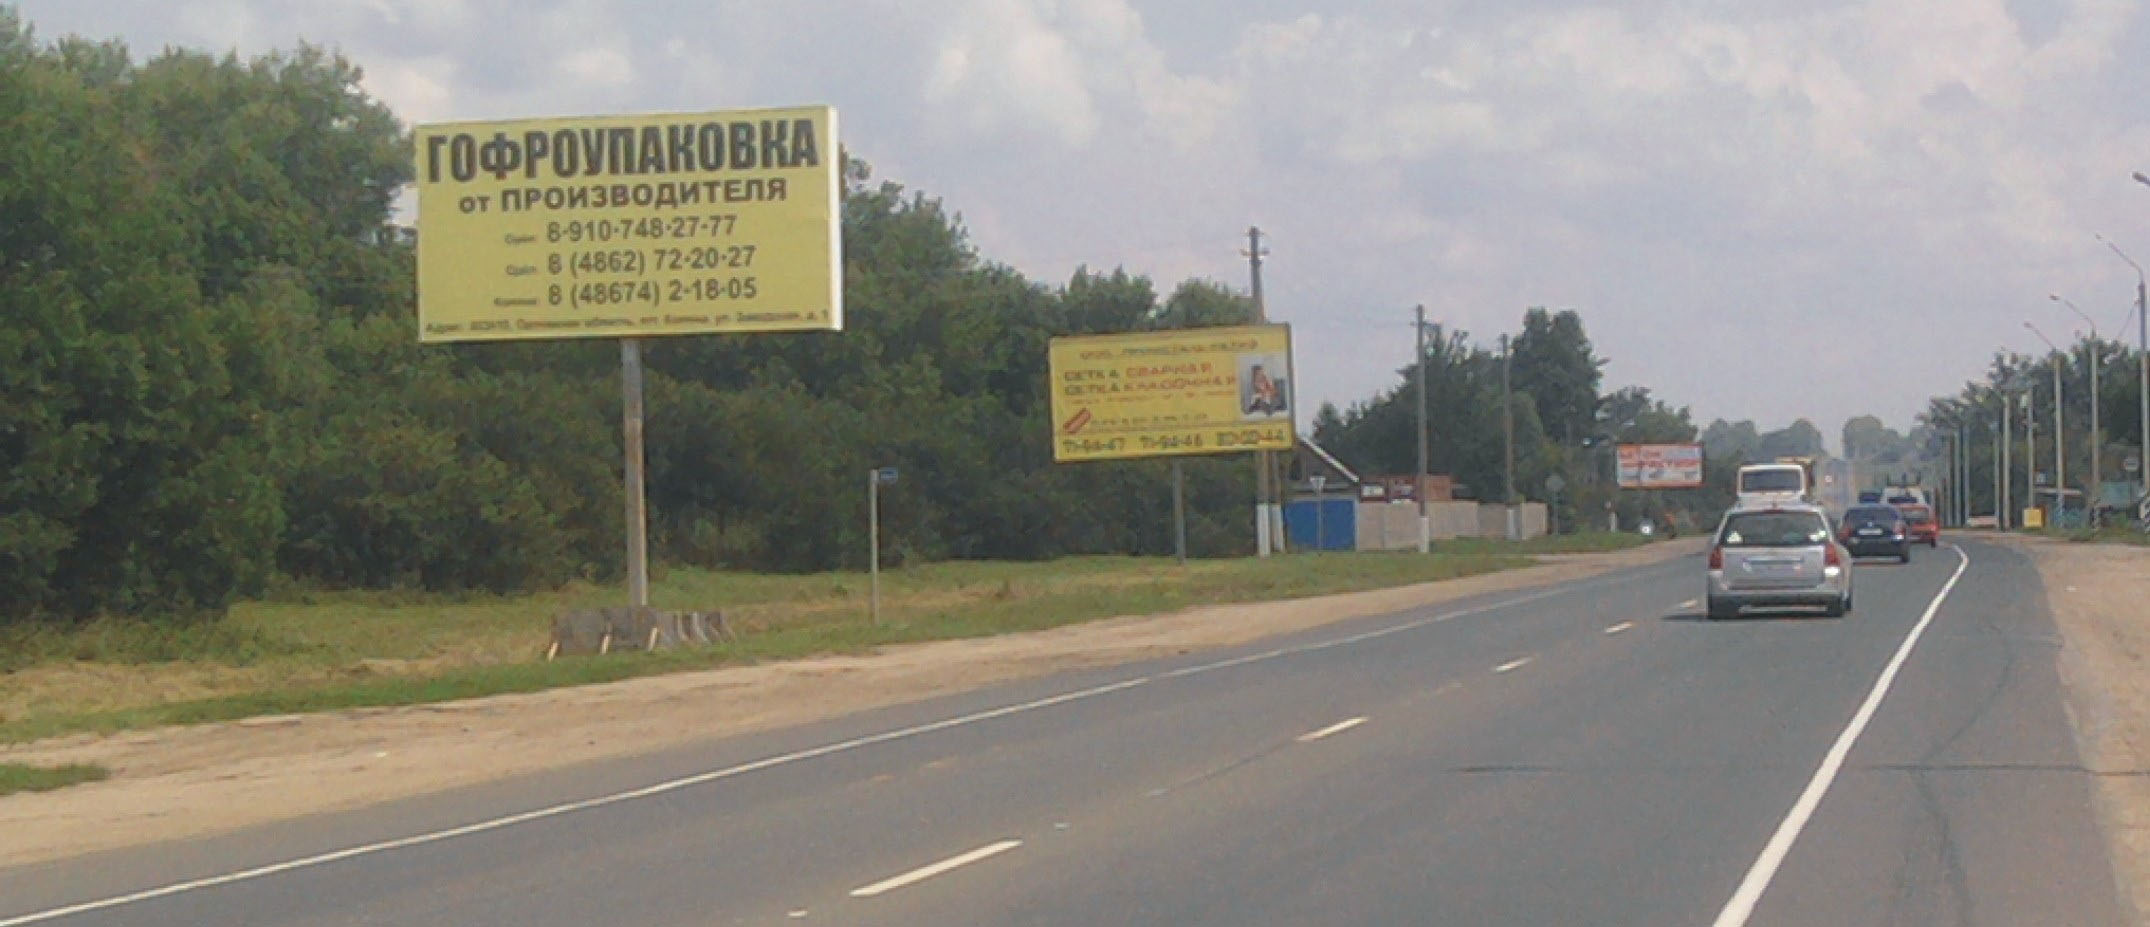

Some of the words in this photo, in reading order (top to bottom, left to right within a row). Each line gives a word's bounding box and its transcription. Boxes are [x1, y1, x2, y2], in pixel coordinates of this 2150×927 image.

[428, 117, 819, 183] ГОФРОУПАКОВКА
[459, 196, 490, 214] от
[501, 177, 787, 212] ПРОИЗВОДИТЕЛЯ
[546, 214, 738, 243] 8-910-748-27-77
[548, 253, 562, 275] 8
[569, 249, 645, 279] (4862)
[654, 244, 758, 270] 72-20-27
[548, 283, 562, 306] 8
[668, 276, 758, 303] 2-18-05
